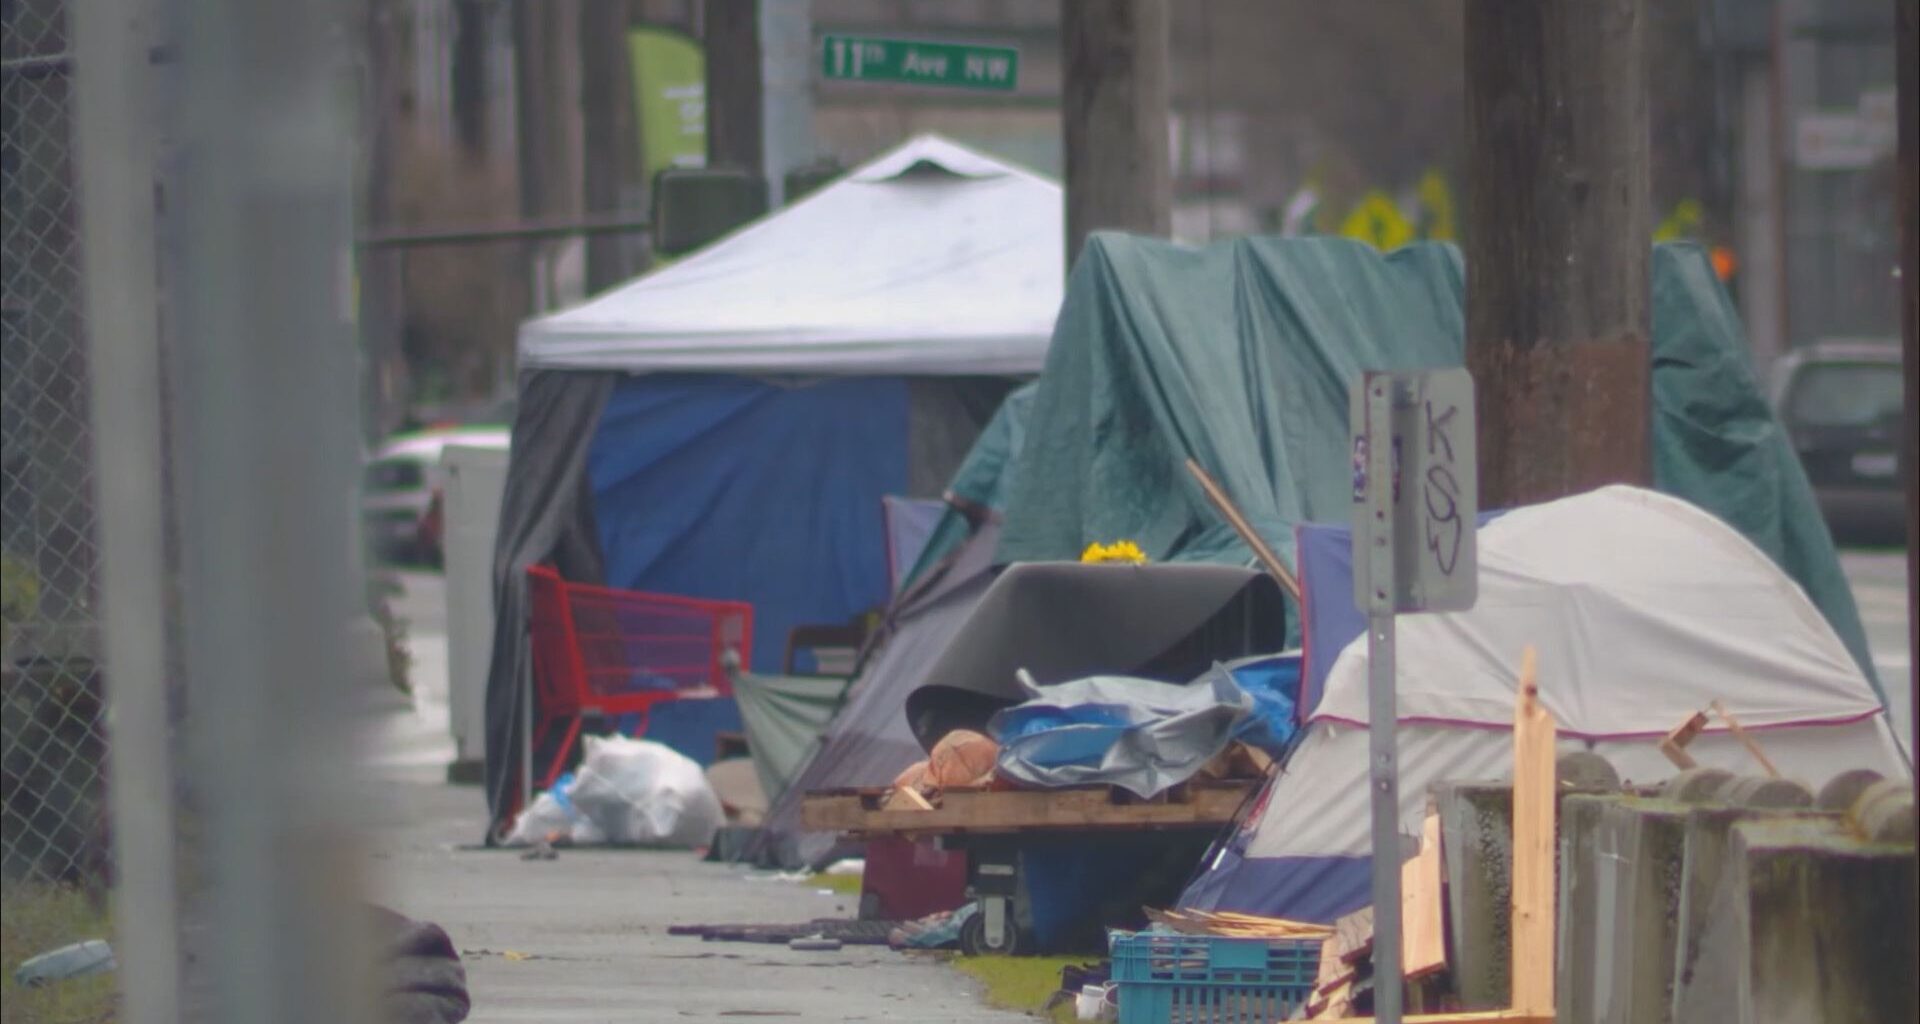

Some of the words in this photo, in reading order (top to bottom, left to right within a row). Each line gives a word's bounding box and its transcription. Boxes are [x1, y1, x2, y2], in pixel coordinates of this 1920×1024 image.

[832, 41, 885, 77] 11th
[903, 50, 947, 78] Ave
[965, 55, 1009, 80] NW
